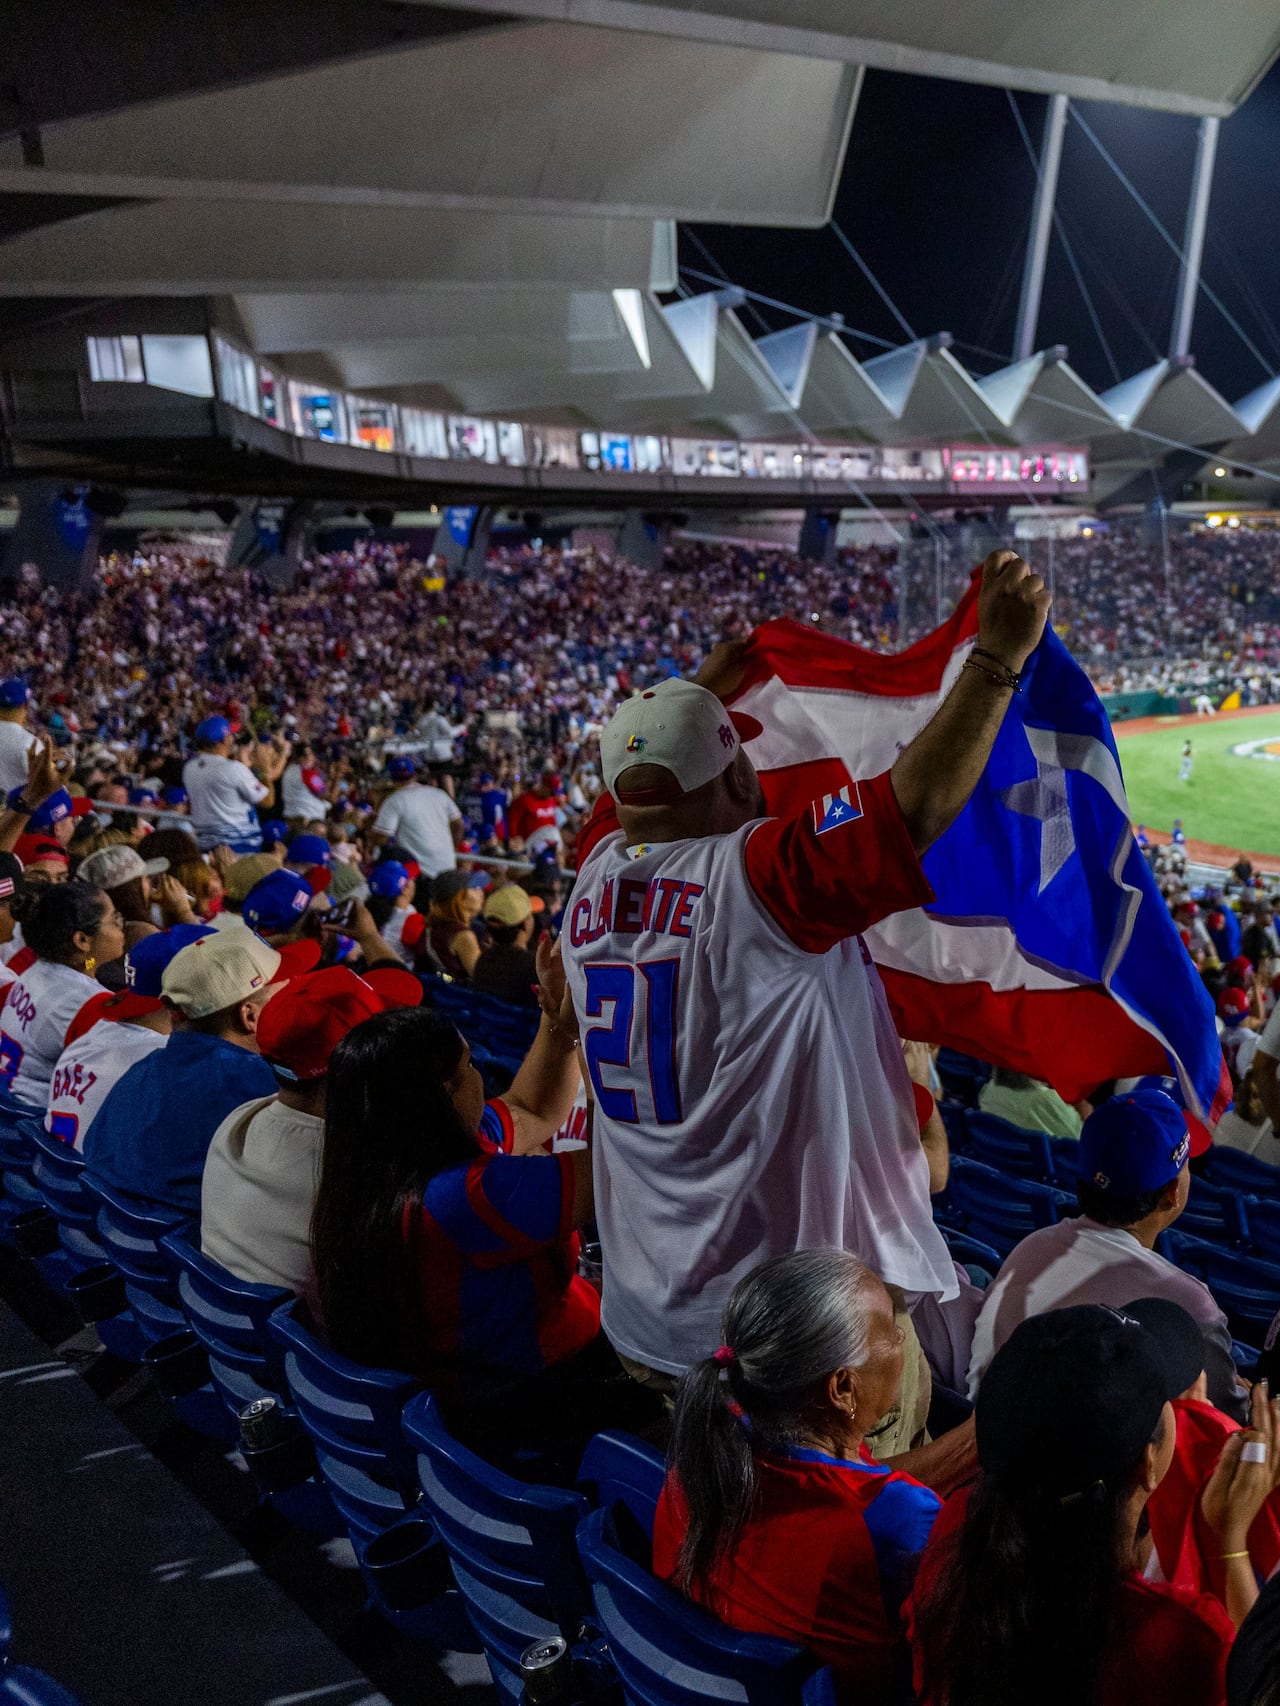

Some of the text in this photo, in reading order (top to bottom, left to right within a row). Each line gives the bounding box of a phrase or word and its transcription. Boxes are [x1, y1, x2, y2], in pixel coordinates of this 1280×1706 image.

[570, 877, 705, 948] CLMENTE
[9, 983, 36, 1033] DOR
[584, 957, 683, 1125] 21
[53, 1064, 97, 1105] BAEZ
